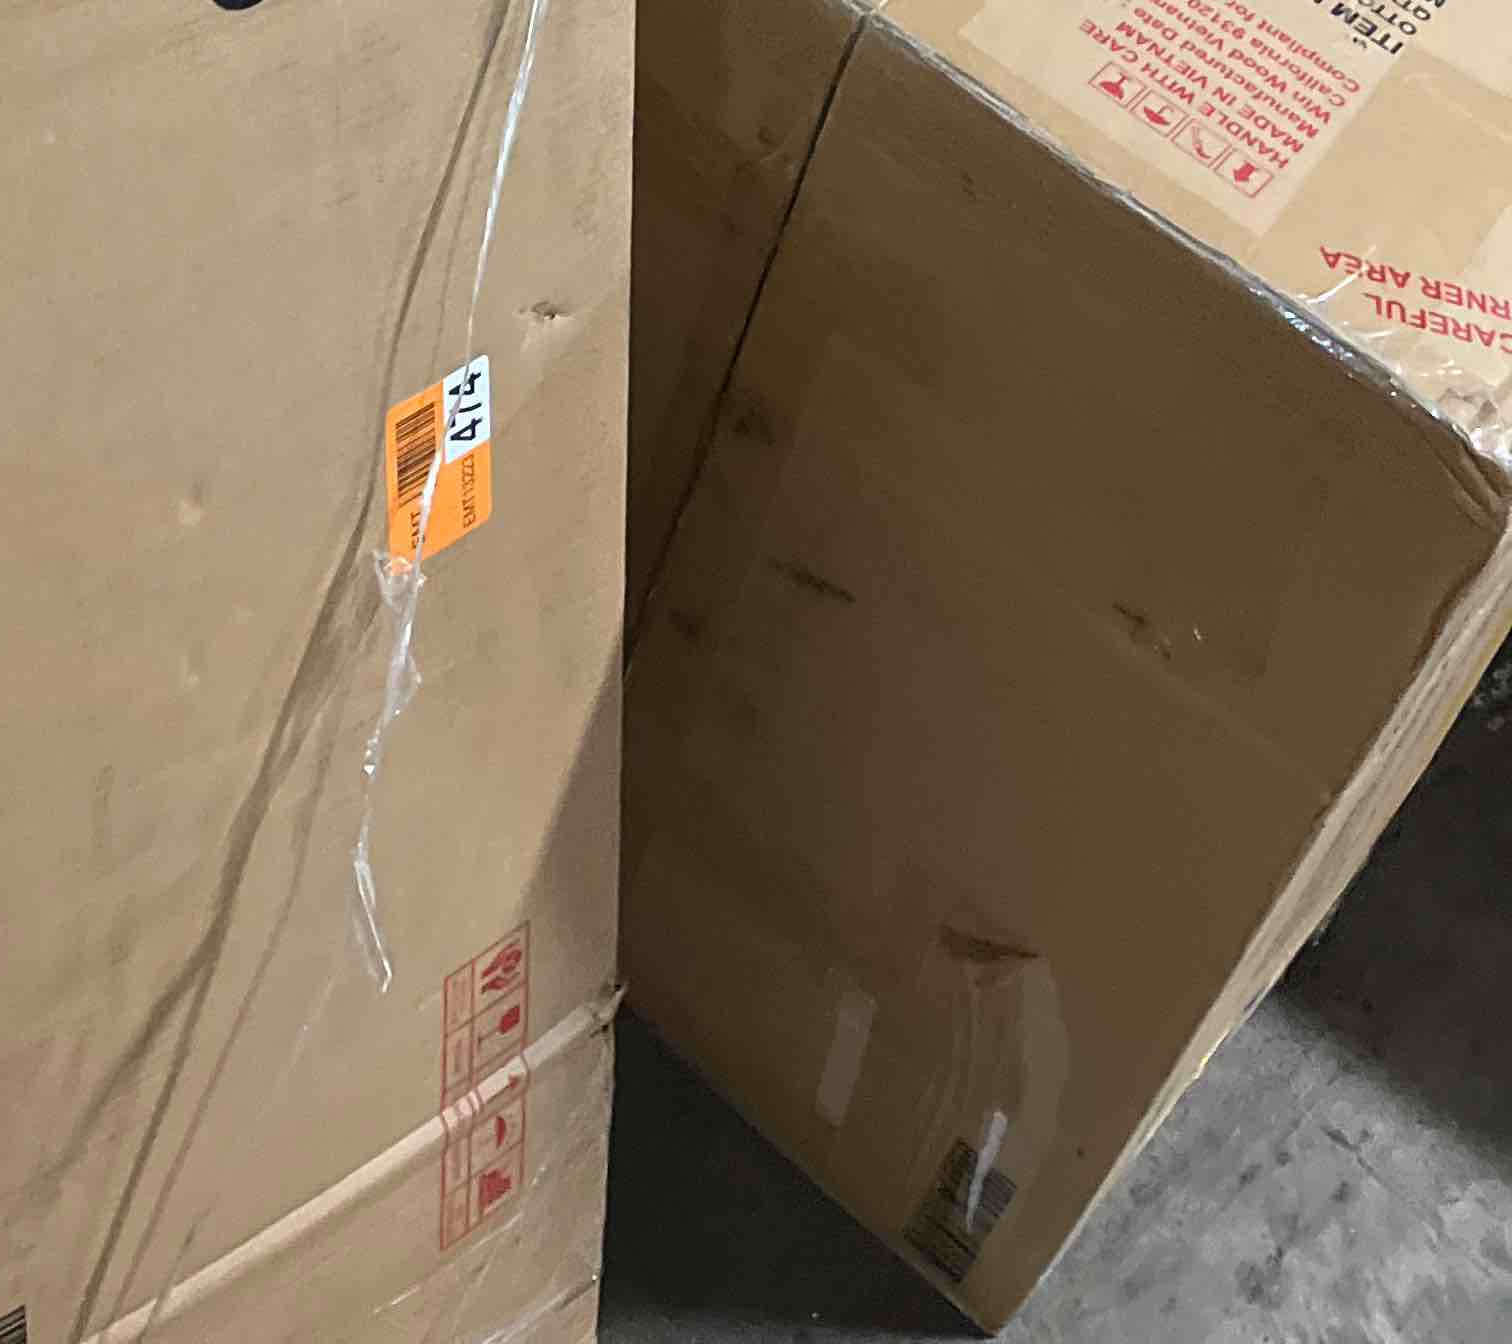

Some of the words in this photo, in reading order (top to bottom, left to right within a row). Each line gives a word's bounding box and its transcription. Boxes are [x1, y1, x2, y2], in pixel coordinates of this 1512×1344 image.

[1134, 8, 1179, 41] Date
[1224, 0, 1256, 22] for
[1330, 2, 1403, 55] ITEM
[1080, 19, 1138, 63] CARE
[1116, 22, 1208, 90] VIETNAM
[1257, 20, 1360, 93] Compliant
[1141, 63, 1195, 105] WITH
[1180, 41, 1319, 139] Manufactured
[1227, 49, 1287, 93] Wood
[1250, 38, 1345, 107] California
[1212, 86, 1237, 106] IN
[1293, 91, 1331, 125] Win
[1199, 102, 1289, 169] HANDLE
[1238, 105, 1304, 153] MADE
[1319, 246, 1412, 289] AREA
